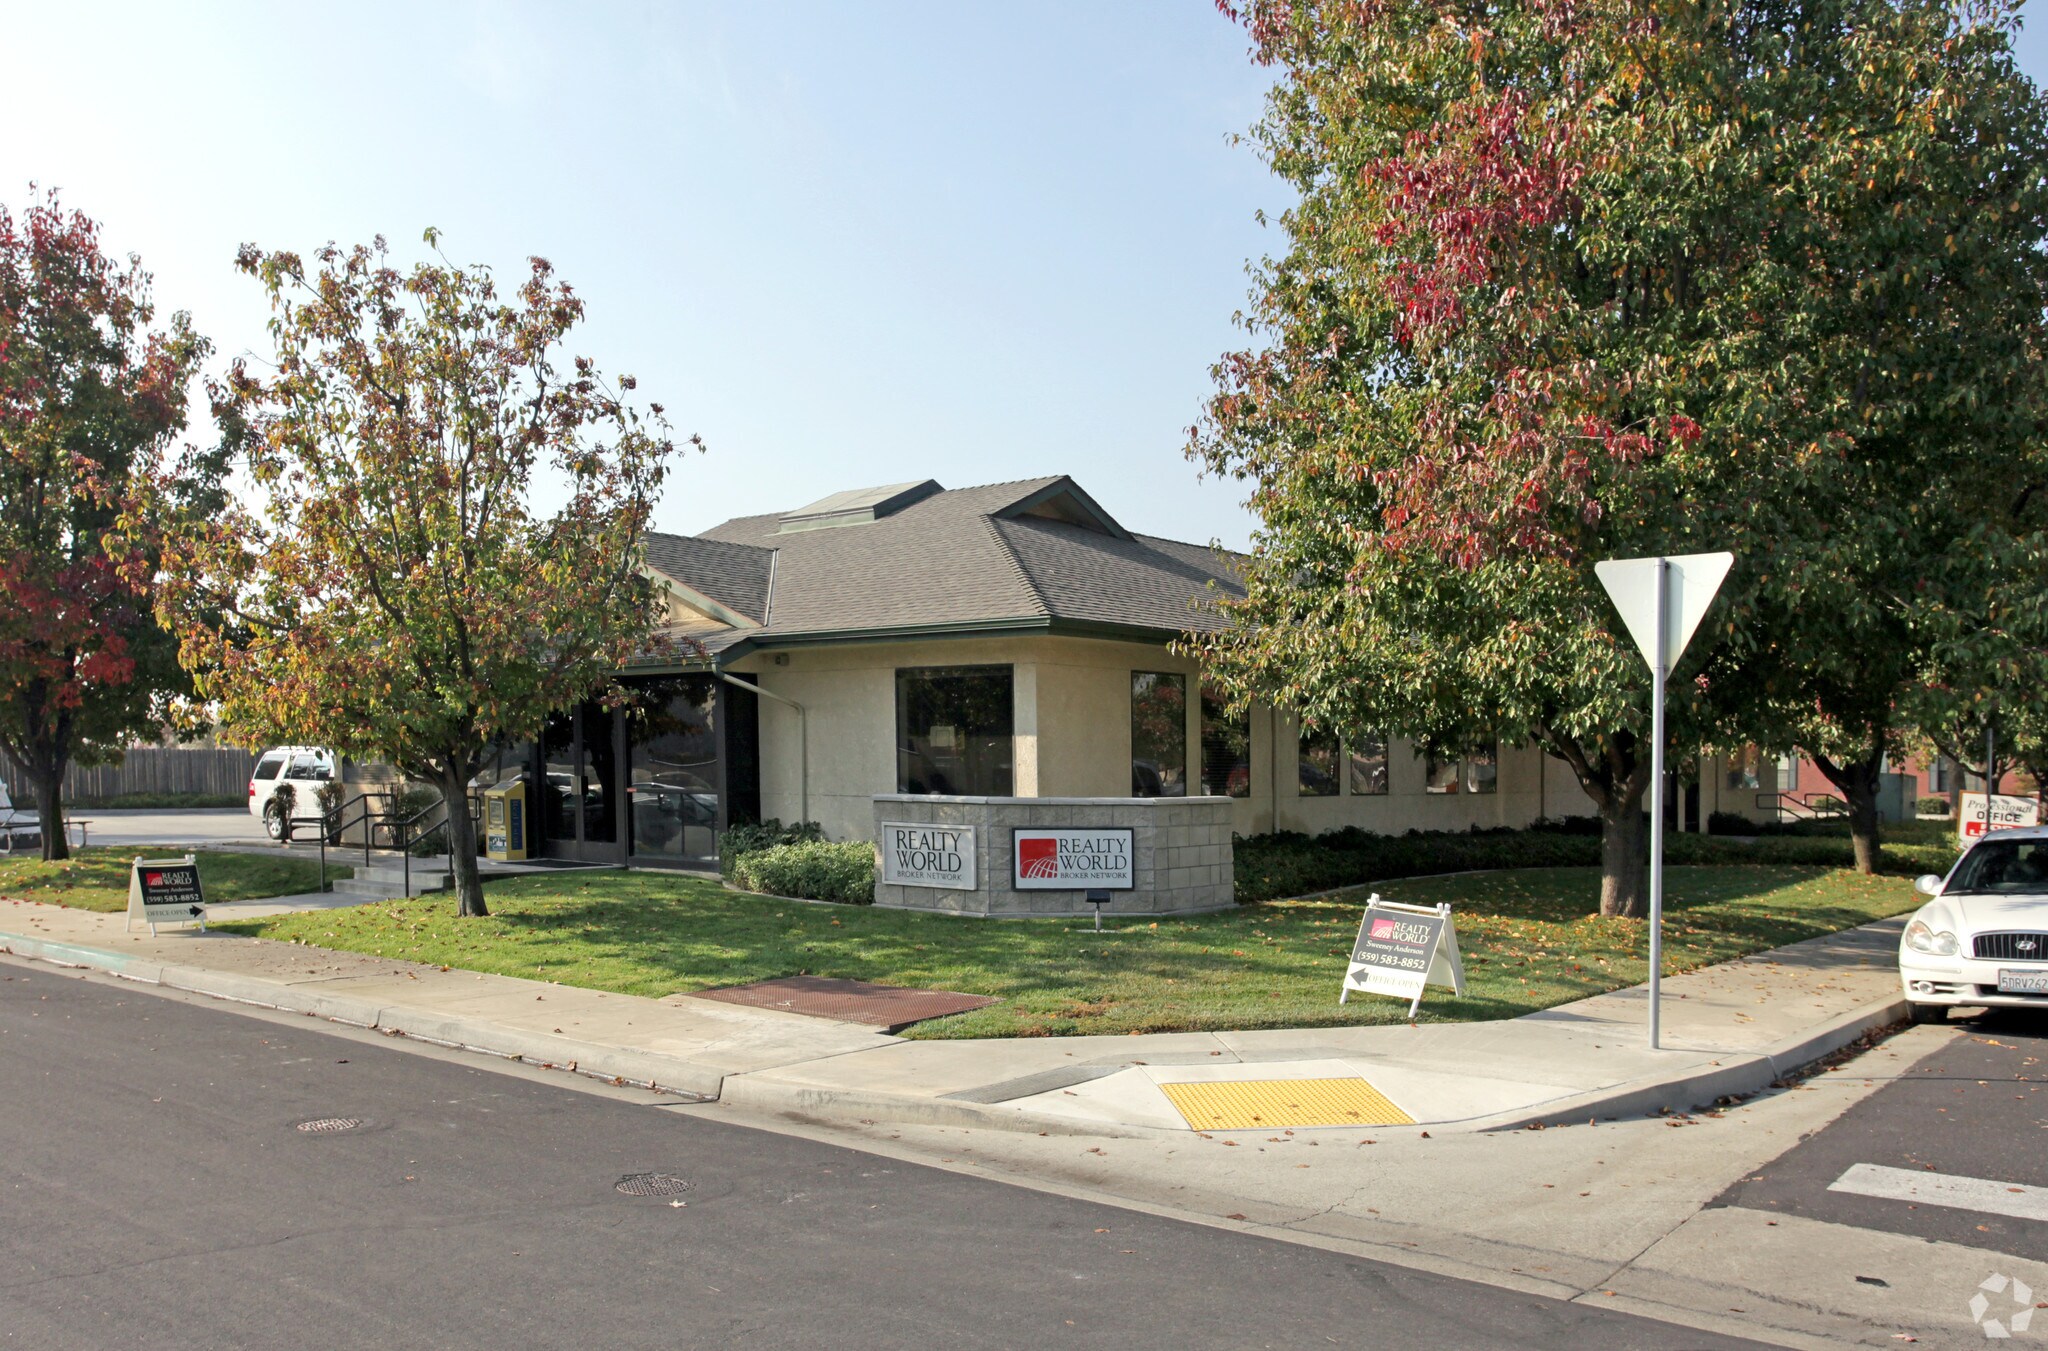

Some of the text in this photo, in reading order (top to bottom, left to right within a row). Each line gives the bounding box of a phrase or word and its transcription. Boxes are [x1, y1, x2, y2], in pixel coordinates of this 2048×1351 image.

[1967, 799, 2032, 813] Proessional
[896, 830, 961, 852] REALTY
[1059, 838, 1127, 853] REALTY
[896, 850, 962, 872] WORLD
[1060, 855, 1127, 870] WORLD
[162, 871, 190, 879] REALTY
[897, 870, 962, 881] BROKER NETWORK
[164, 894, 199, 902] 583-8852
[1393, 921, 1431, 935] REALTY
[1392, 931, 1428, 944] WORLD
[1366, 940, 1423, 955] Sweeney Anderson
[1358, 951, 1425, 969] (559) 583-8852
[2001, 977, 2048, 989] 5DRV262
